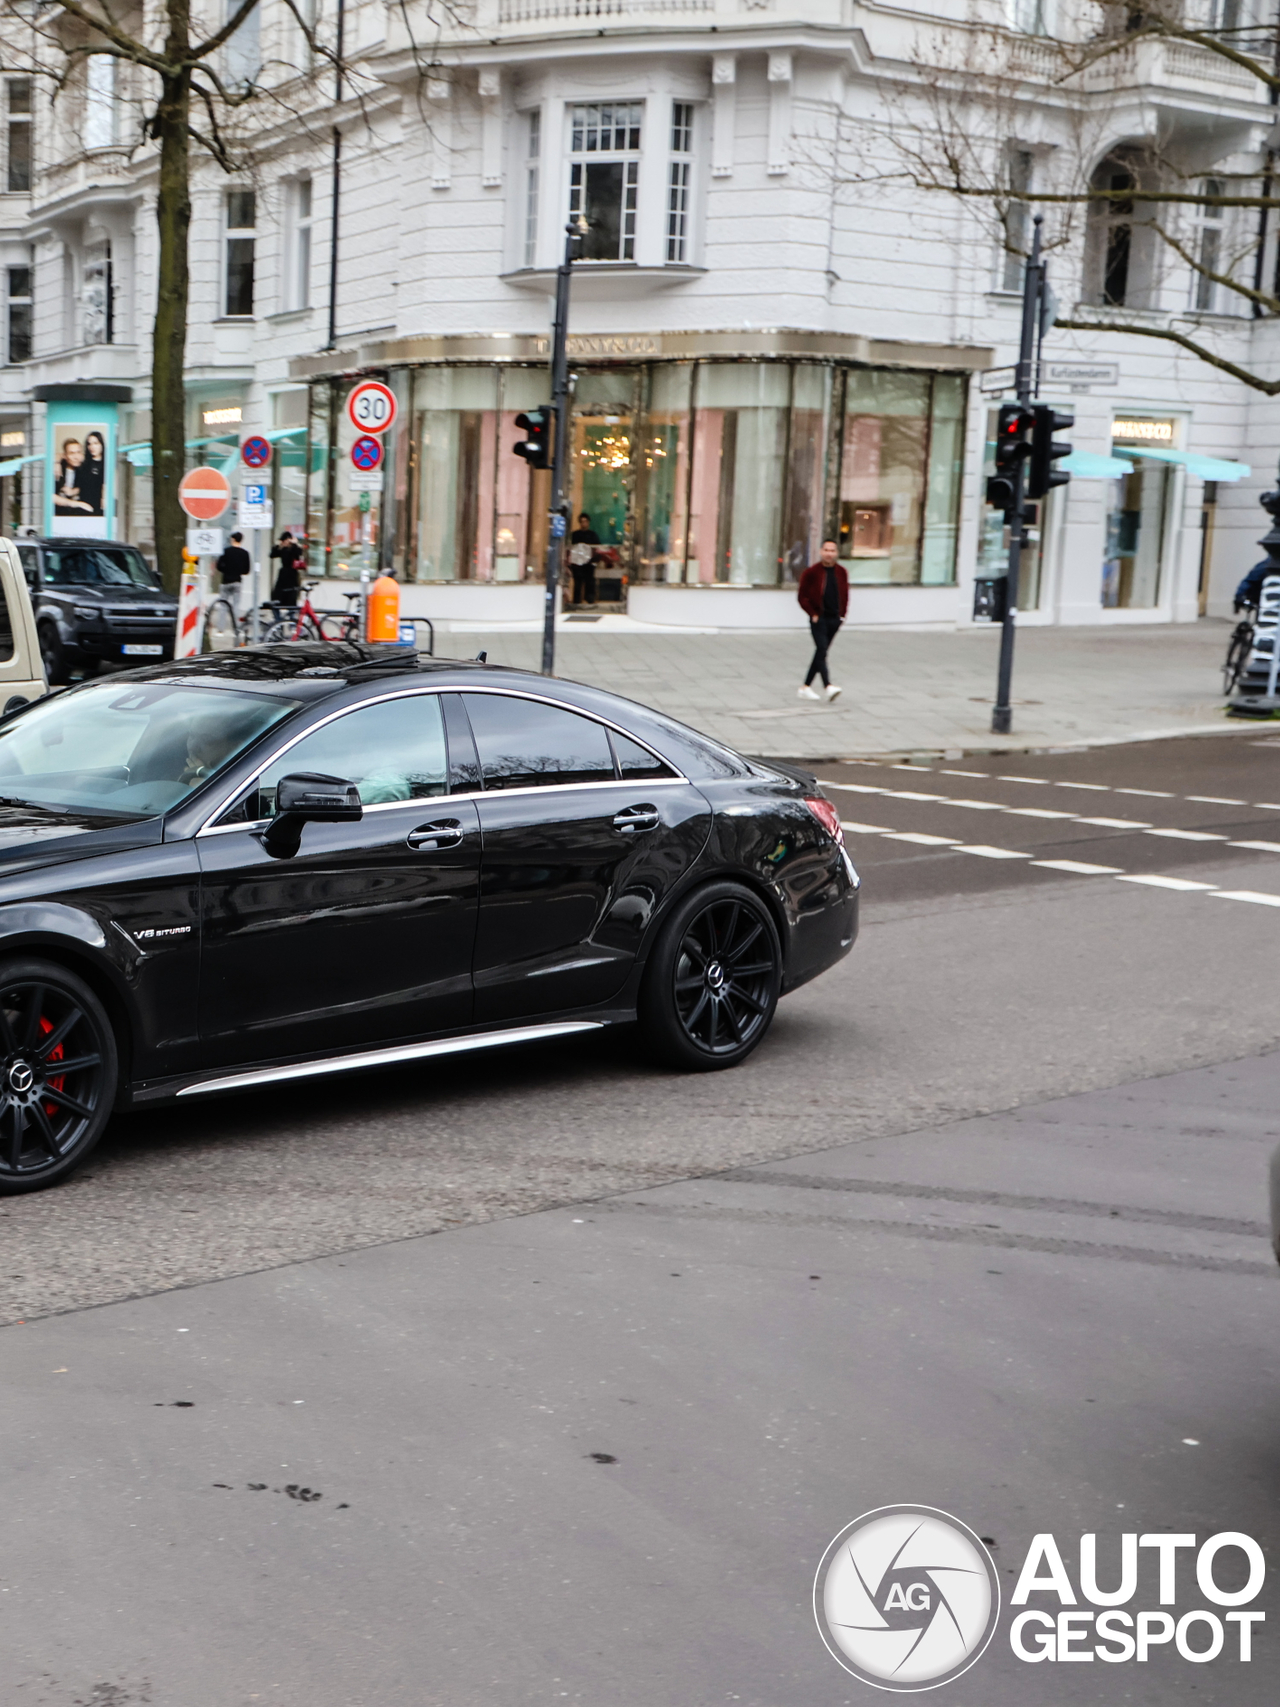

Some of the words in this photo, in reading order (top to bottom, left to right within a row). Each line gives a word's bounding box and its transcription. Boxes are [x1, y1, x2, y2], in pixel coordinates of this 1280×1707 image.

[358, 397, 386, 420] 30
[247, 486, 261, 503] P
[133, 929, 155, 939] V8
[155, 926, 191, 937] BITURBO
